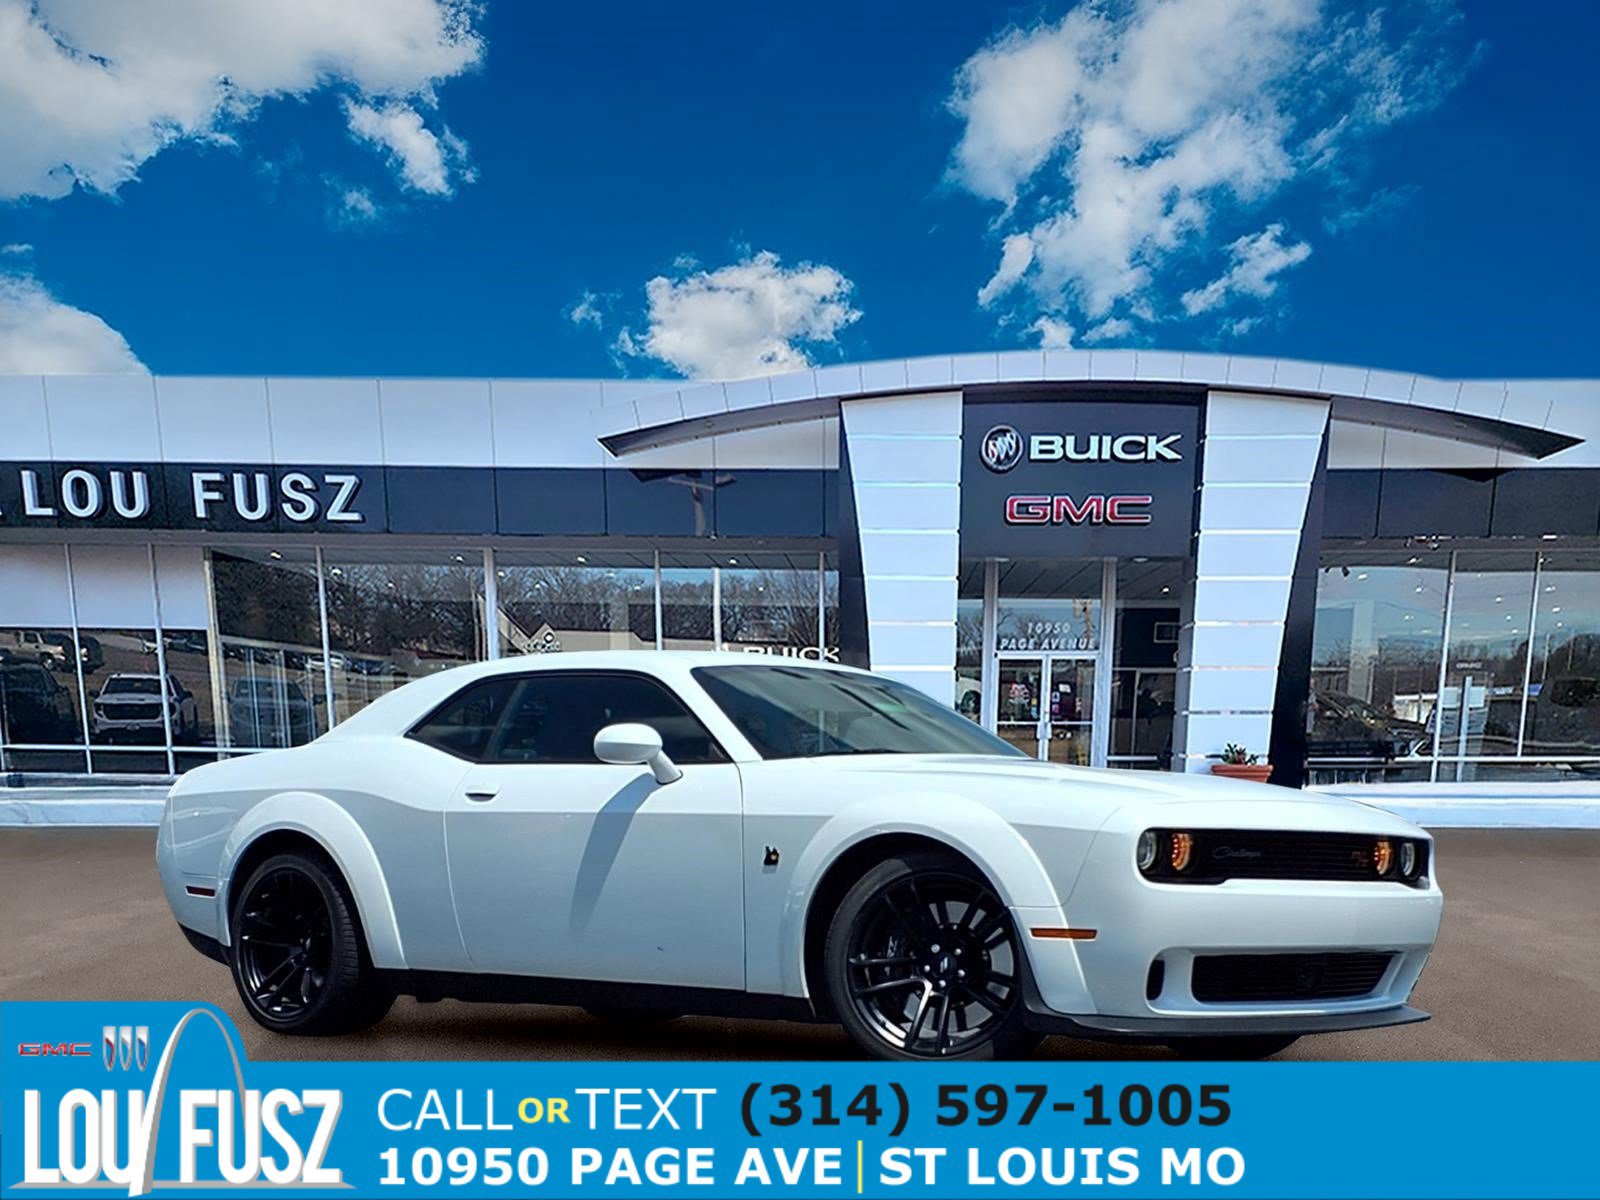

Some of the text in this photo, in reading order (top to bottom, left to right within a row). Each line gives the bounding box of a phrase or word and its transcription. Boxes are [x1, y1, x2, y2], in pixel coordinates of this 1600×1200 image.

[1029, 434, 1183, 460] BUICK
[20, 469, 363, 522] LOU FUSZ
[1005, 495, 1153, 524] GMC
[1027, 622, 1071, 634] 10950
[1000, 638, 1096, 650] PAGE AVENUE
